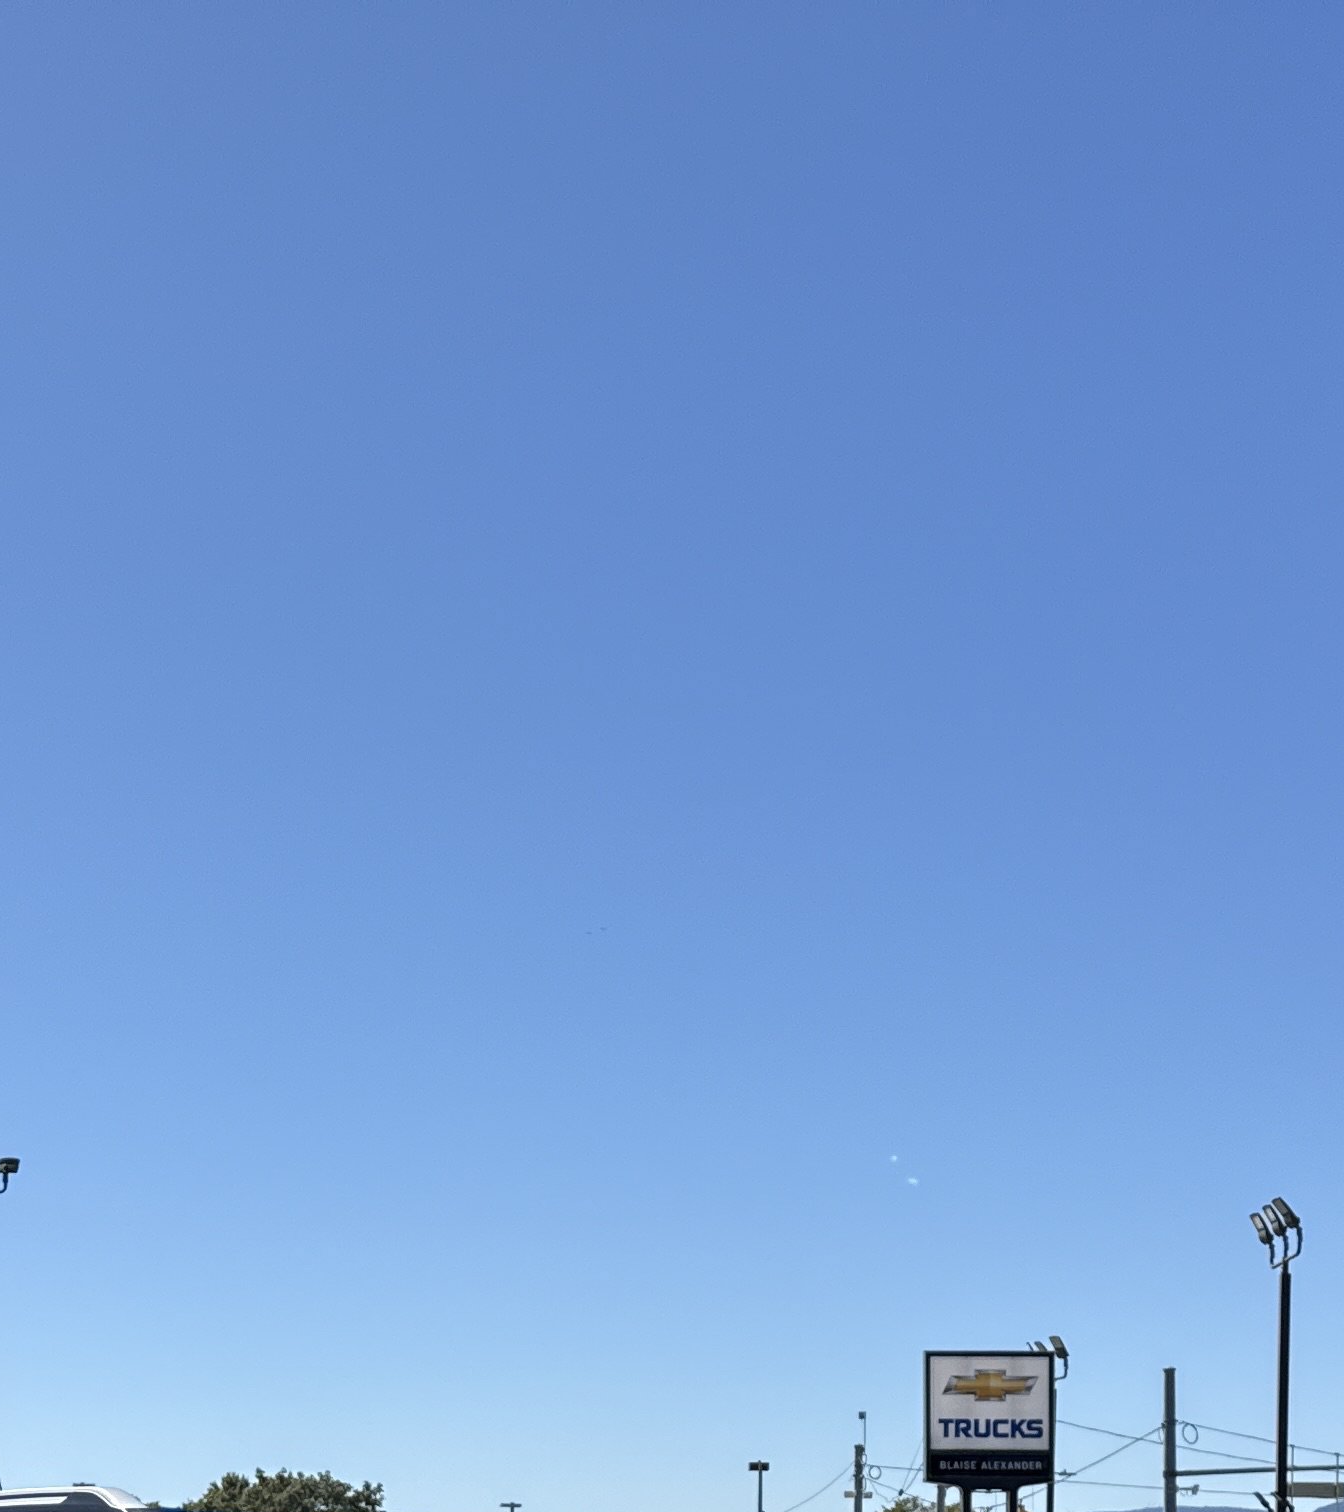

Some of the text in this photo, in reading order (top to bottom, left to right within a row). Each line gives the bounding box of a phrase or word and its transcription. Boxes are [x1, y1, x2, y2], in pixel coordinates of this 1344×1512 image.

[938, 1418, 1044, 1439] TRUCKS
[939, 1460, 1043, 1470] BLAISE ALEXANDER
